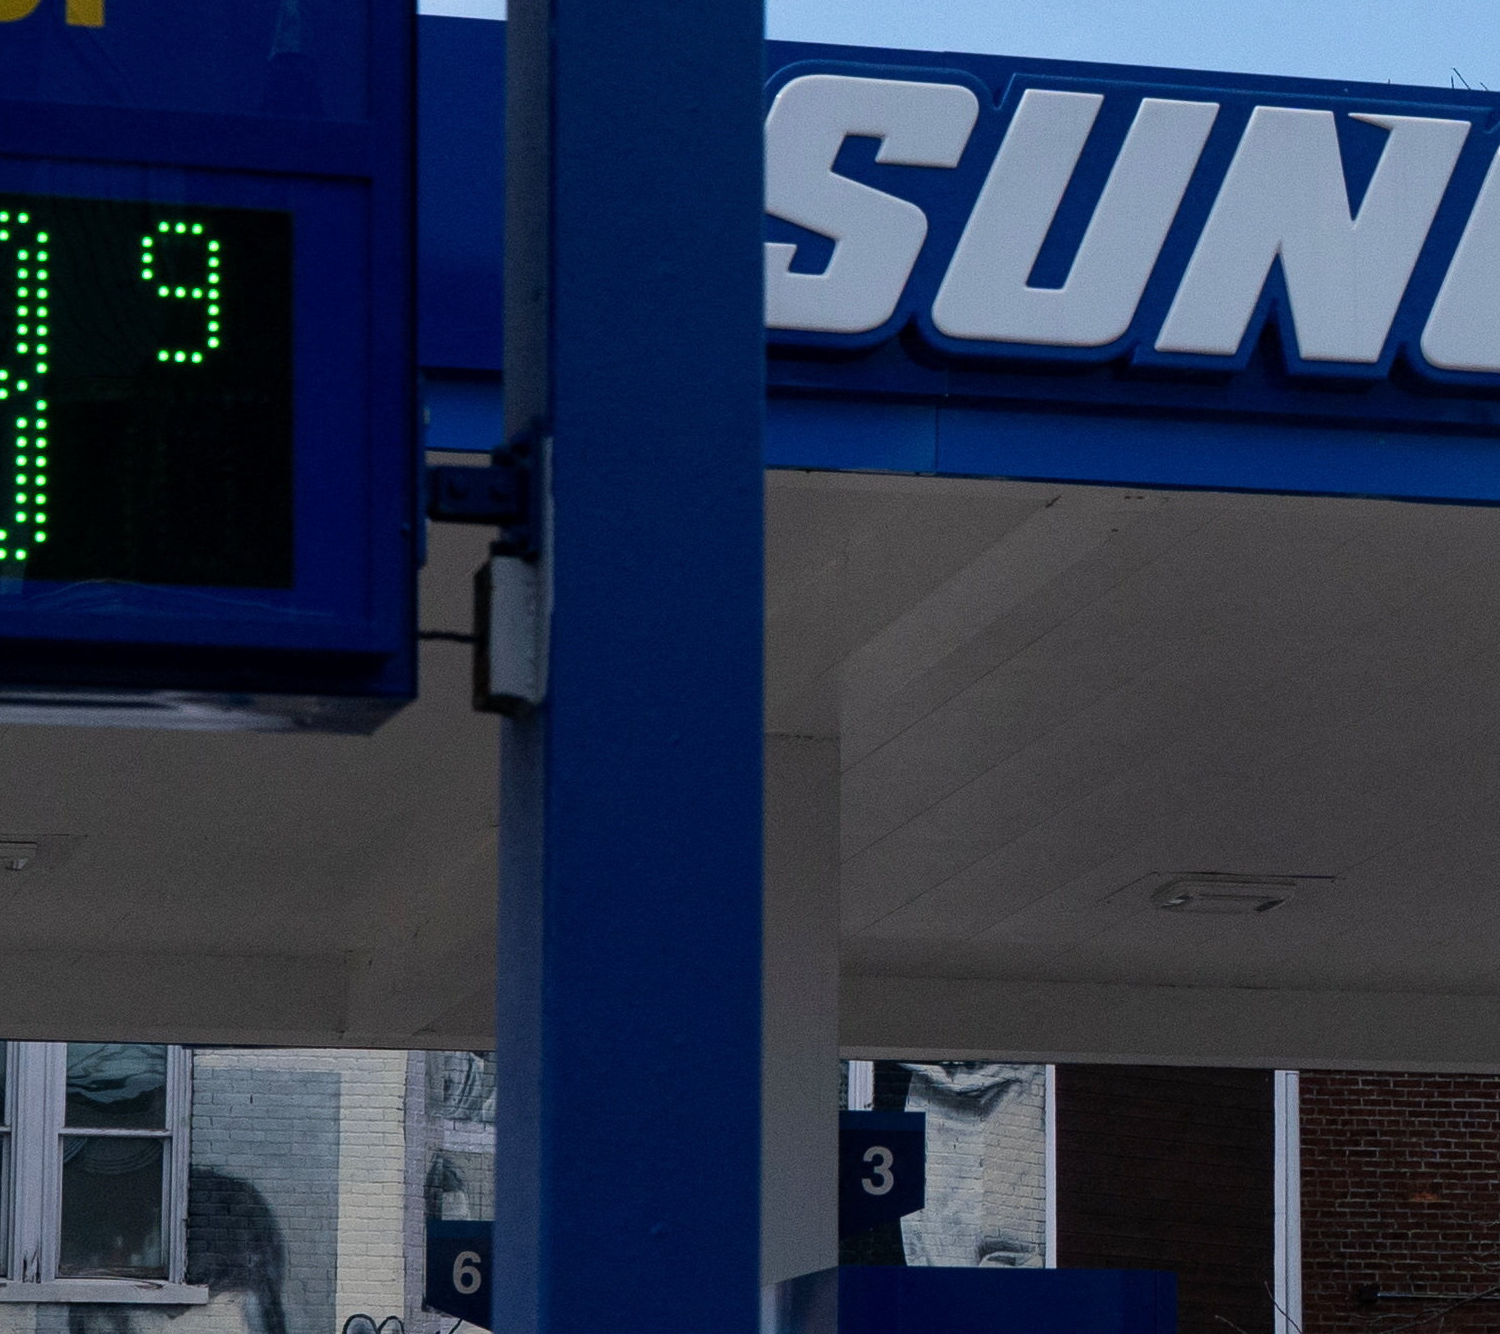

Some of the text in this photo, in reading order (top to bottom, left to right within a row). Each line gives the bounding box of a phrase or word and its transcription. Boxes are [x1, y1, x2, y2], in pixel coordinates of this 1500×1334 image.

[140, 220, 223, 364] 9
[861, 1146, 894, 1197] 3
[452, 1251, 483, 1295] 6
